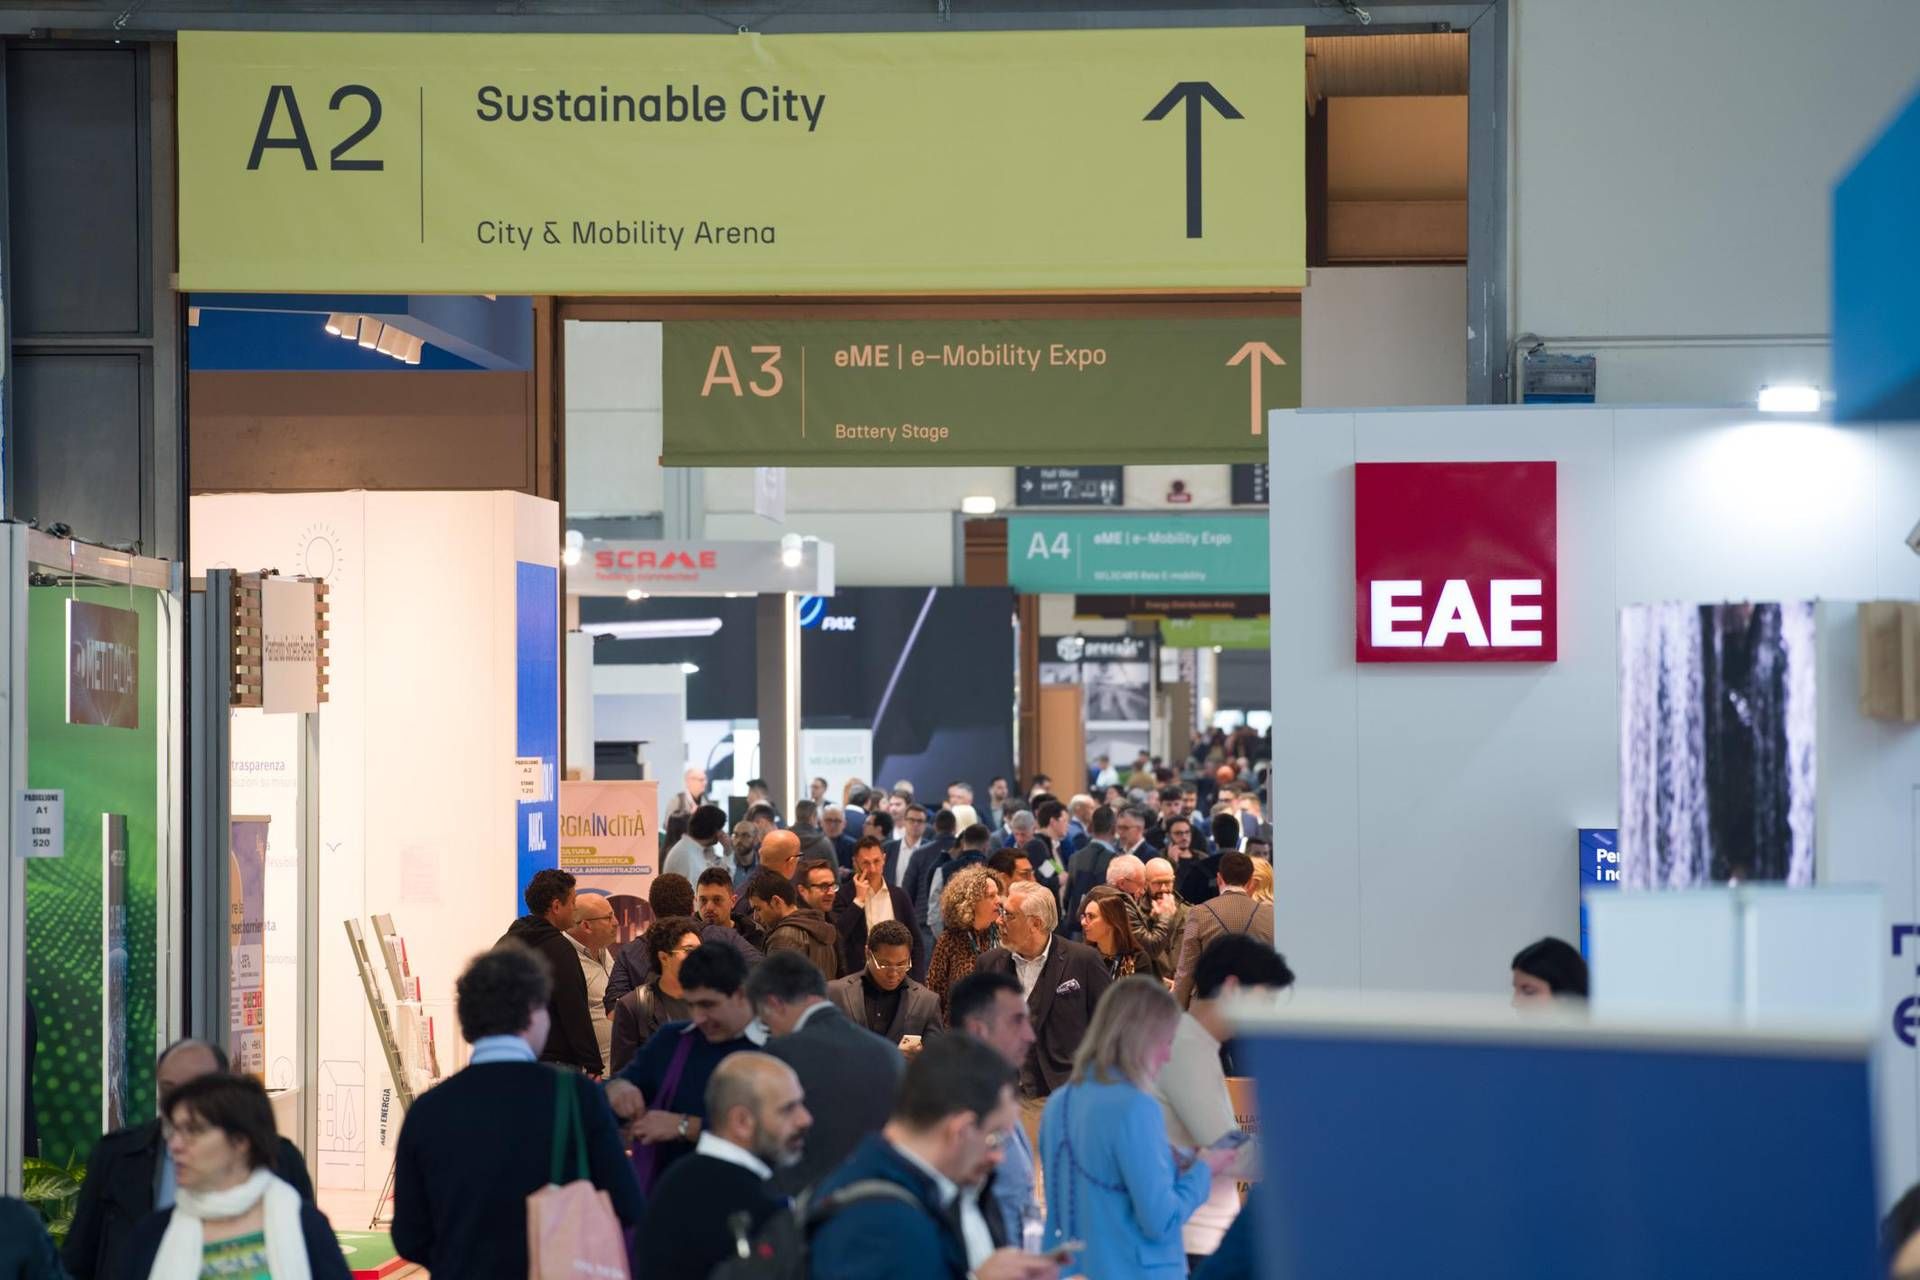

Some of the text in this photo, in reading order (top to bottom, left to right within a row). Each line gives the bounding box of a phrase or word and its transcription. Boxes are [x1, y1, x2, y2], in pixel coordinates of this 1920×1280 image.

[477, 85, 826, 132] Sustainable City
[246, 84, 384, 170] A2
[477, 220, 776, 251] City & Mobility Arena
[700, 345, 784, 397] A3
[834, 345, 889, 368] eME
[1049, 345, 1107, 371] Expo
[834, 423, 949, 443] Battery Stage
[1027, 532, 1070, 560] A4
[1093, 531, 1122, 545] eME
[1201, 531, 1232, 547] Expo
[595, 550, 718, 569] SCAME
[821, 616, 856, 631] PAX
[1371, 579, 1542, 647] EAE
[36, 806, 48, 814] A1
[33, 839, 50, 847] 520
[380, 1088, 391, 1123] ENERGIA
